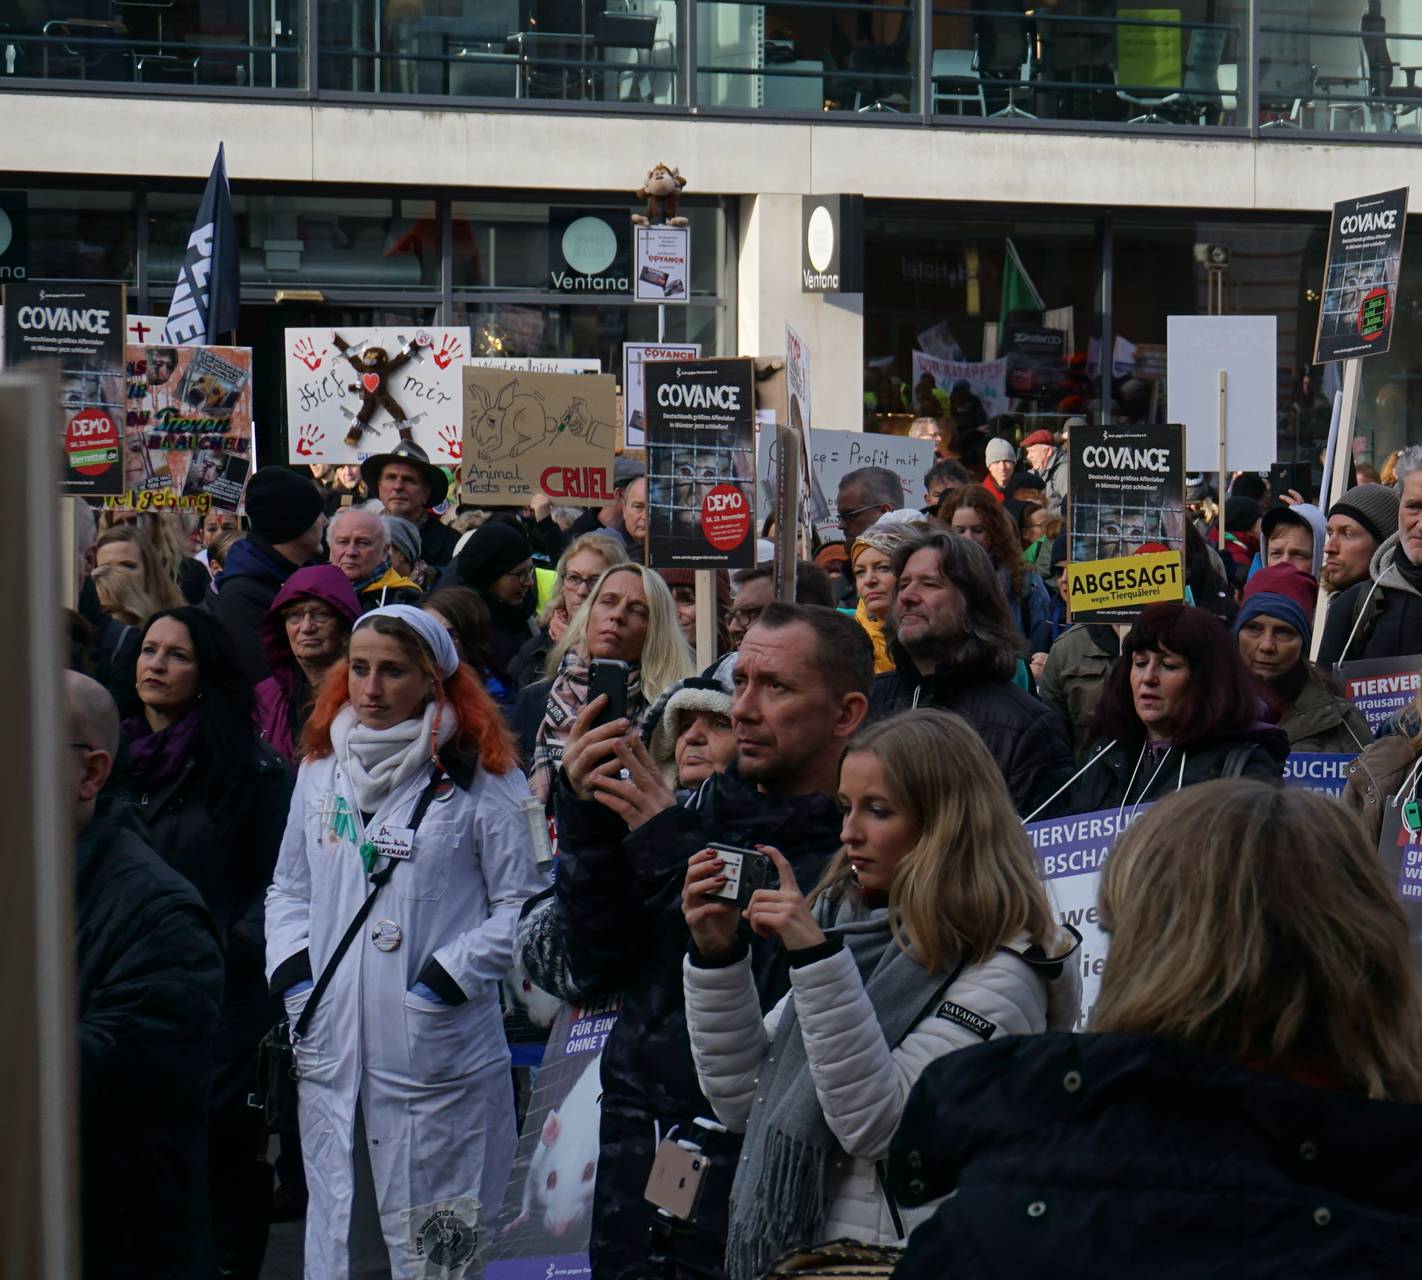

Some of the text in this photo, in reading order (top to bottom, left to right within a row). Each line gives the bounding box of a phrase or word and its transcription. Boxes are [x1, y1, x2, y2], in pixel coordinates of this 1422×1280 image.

[1340, 209, 1397, 235] COVANCE
[551, 271, 629, 290] Ventana
[803, 268, 838, 289] Ventana
[18, 305, 110, 335] COVANCE
[644, 348, 694, 361] COVANCE
[403, 376, 451, 405] mir
[657, 383, 740, 411] COVANCE
[72, 418, 110, 436] DEMO
[850, 442, 889, 467] Profit
[896, 453, 919, 466] mit
[1082, 445, 1170, 472] COVANCE
[467, 464, 523, 480] Animal
[540, 466, 616, 499] CRUEL
[465, 481, 532, 494] Tests are
[707, 492, 742, 512] DEMO
[1071, 563, 1179, 596] ABGESAGT
[1091, 586, 1160, 604] wegen Tierquälerei
[1351, 674, 1421, 697] TIERVER
[570, 1016, 618, 1038] FÜR EIN
[566, 1036, 598, 1054] OHNE
